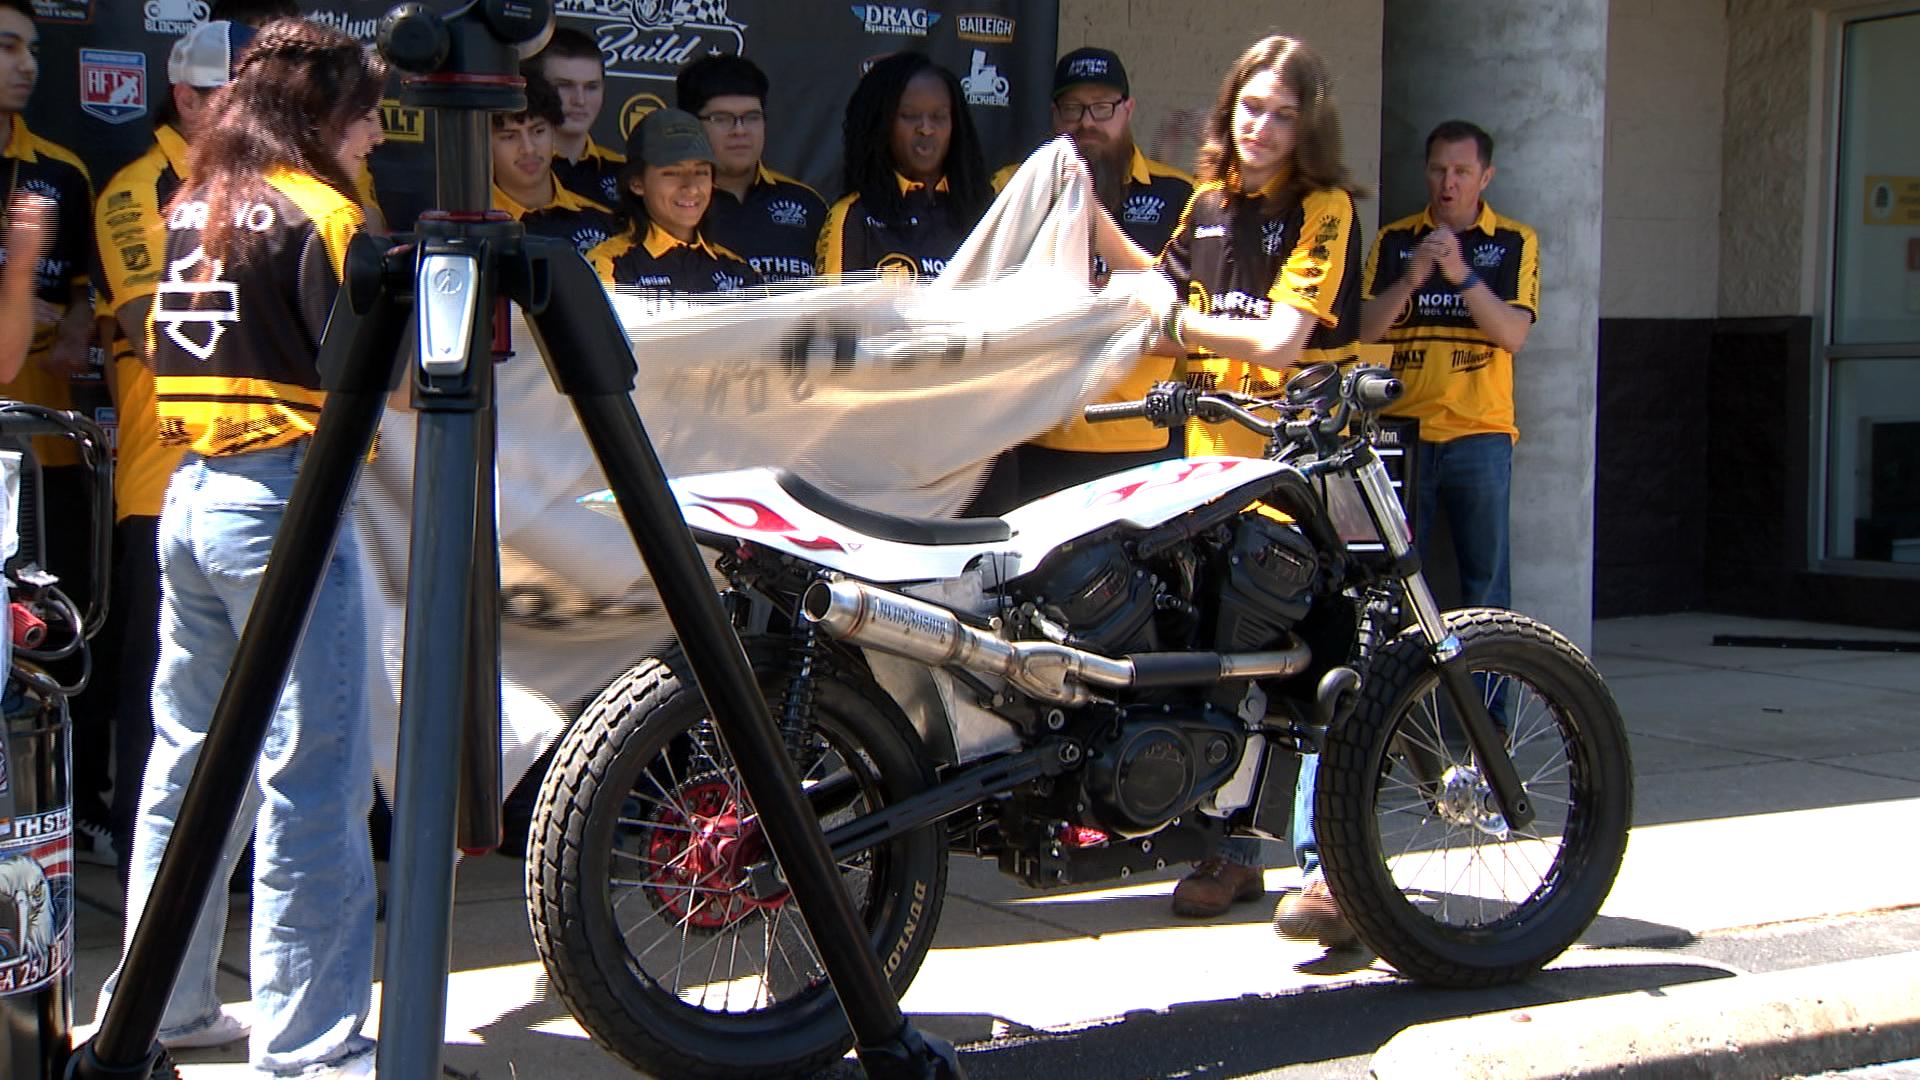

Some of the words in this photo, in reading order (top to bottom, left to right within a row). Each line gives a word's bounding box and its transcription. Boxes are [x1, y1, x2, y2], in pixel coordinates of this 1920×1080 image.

[865, 5, 927, 28] DRAG
[865, 23, 928, 36] Specialties
[959, 17, 1013, 35] BAILEIGH
[596, 24, 702, 67] Build
[966, 93, 1010, 106] LOCKHEAD
[1418, 294, 1466, 307] NORT
